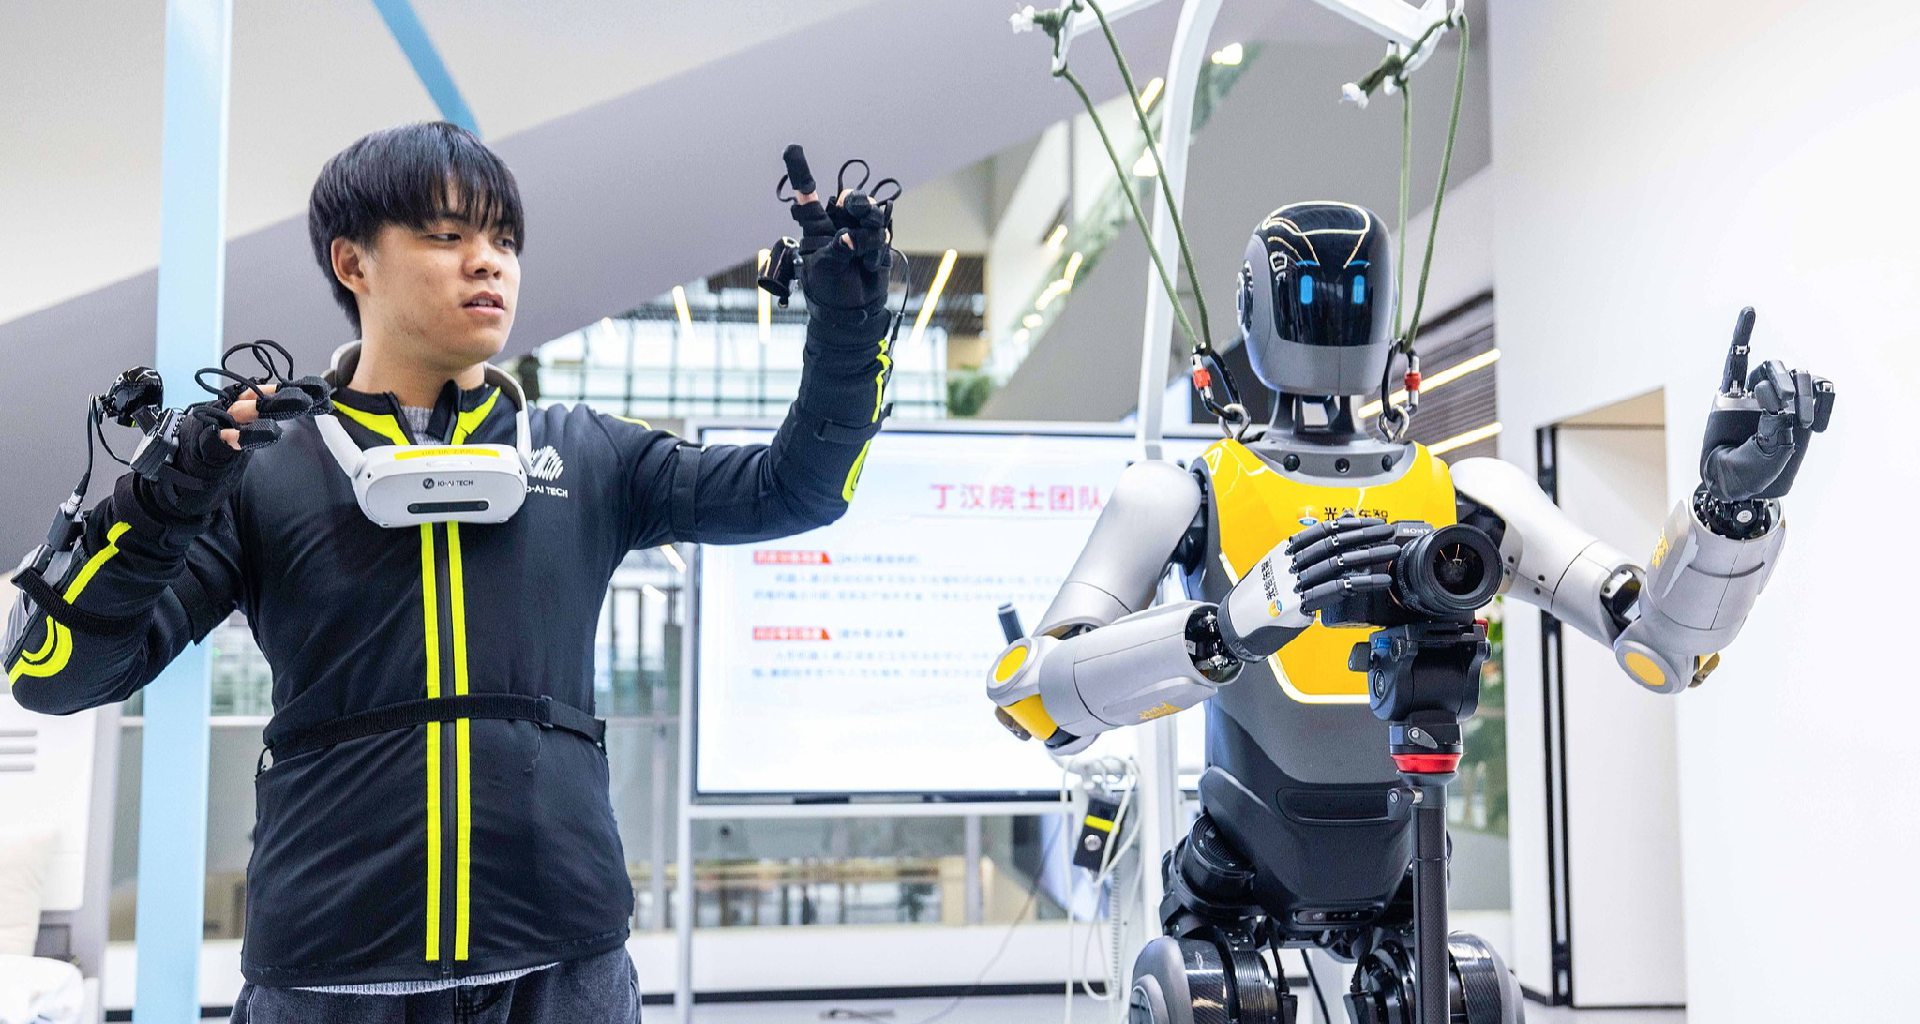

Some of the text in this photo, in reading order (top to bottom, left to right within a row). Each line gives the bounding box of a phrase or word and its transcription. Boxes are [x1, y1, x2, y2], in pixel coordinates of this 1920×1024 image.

[546, 486, 568, 498] TECH
[929, 484, 1105, 511] 丁汉院士团队
